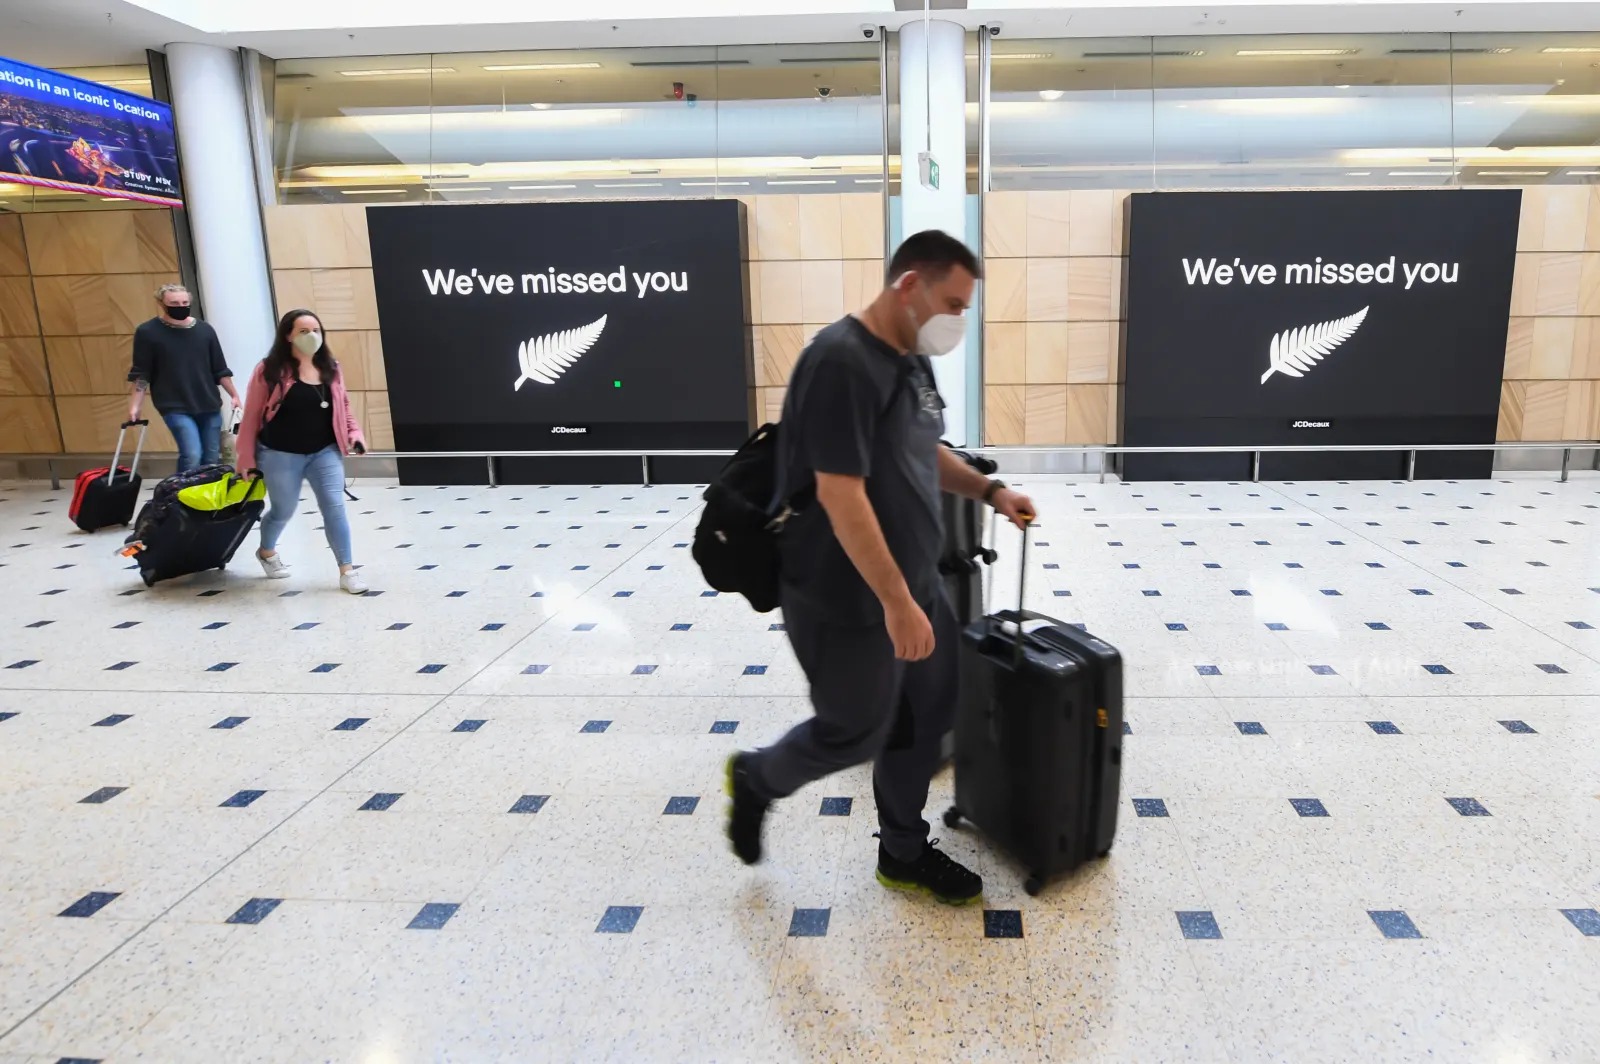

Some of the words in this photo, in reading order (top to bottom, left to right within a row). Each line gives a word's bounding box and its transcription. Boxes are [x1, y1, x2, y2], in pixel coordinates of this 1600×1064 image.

[36, 79, 50, 92] in
[53, 85, 70, 97] an
[73, 88, 110, 108] iconic
[113, 98, 160, 121] location
[124, 170, 151, 182] STUDY
[422, 268, 514, 295] We've
[522, 266, 627, 294] missed
[633, 271, 688, 298] you
[1182, 257, 1277, 285] We've
[1285, 256, 1396, 284] missed
[1403, 262, 1459, 289] you
[551, 426, 587, 434] JCDecaux
[1292, 420, 1330, 428] JCDecaux
